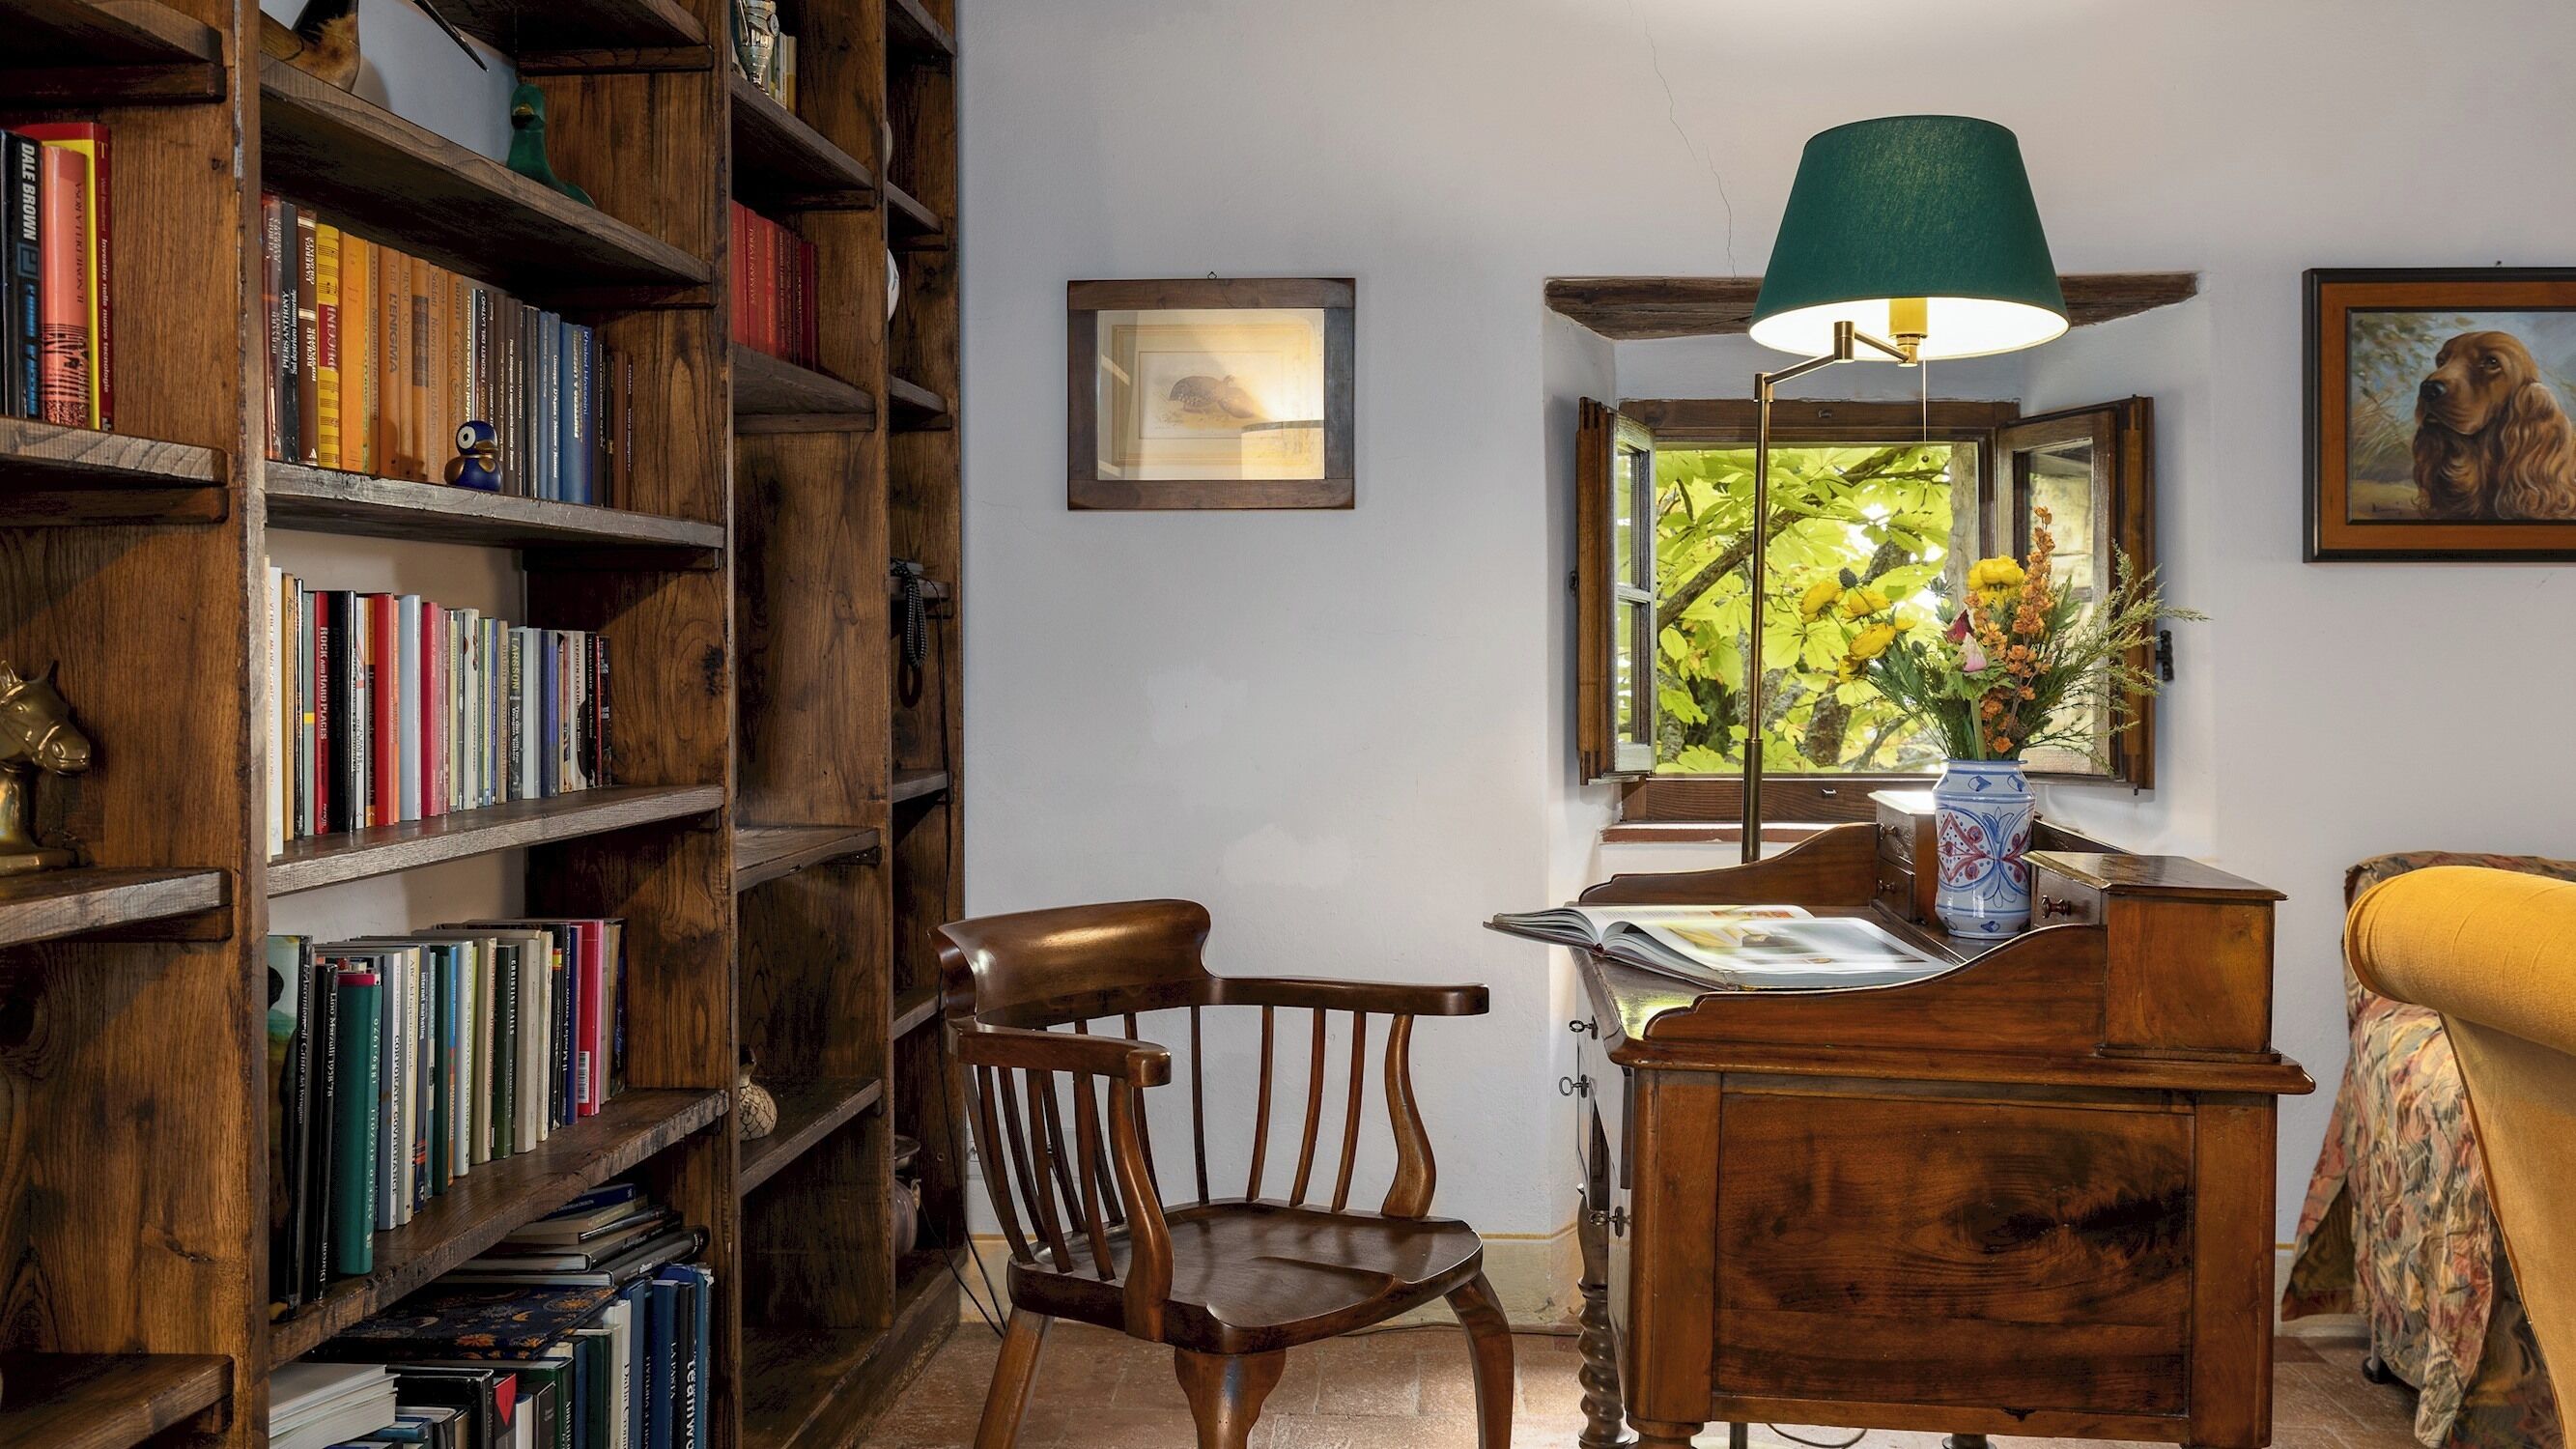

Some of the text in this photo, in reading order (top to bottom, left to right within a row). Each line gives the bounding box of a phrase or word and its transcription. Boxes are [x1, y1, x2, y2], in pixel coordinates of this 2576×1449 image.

[21, 143, 37, 242] DALE BROWN
[326, 306, 337, 366] PUCCINI
[388, 293, 398, 373] L'ENIGMA
[320, 626, 328, 659] ROCK
[511, 637, 520, 690] LARSSON
[320, 674, 328, 702] HARD
[501, 684, 506, 696] UP
[391, 1110, 400, 1197] GOVERNANCE
[319, 1241, 327, 1282] Diarcon
[669, 1341, 677, 1359] LA
